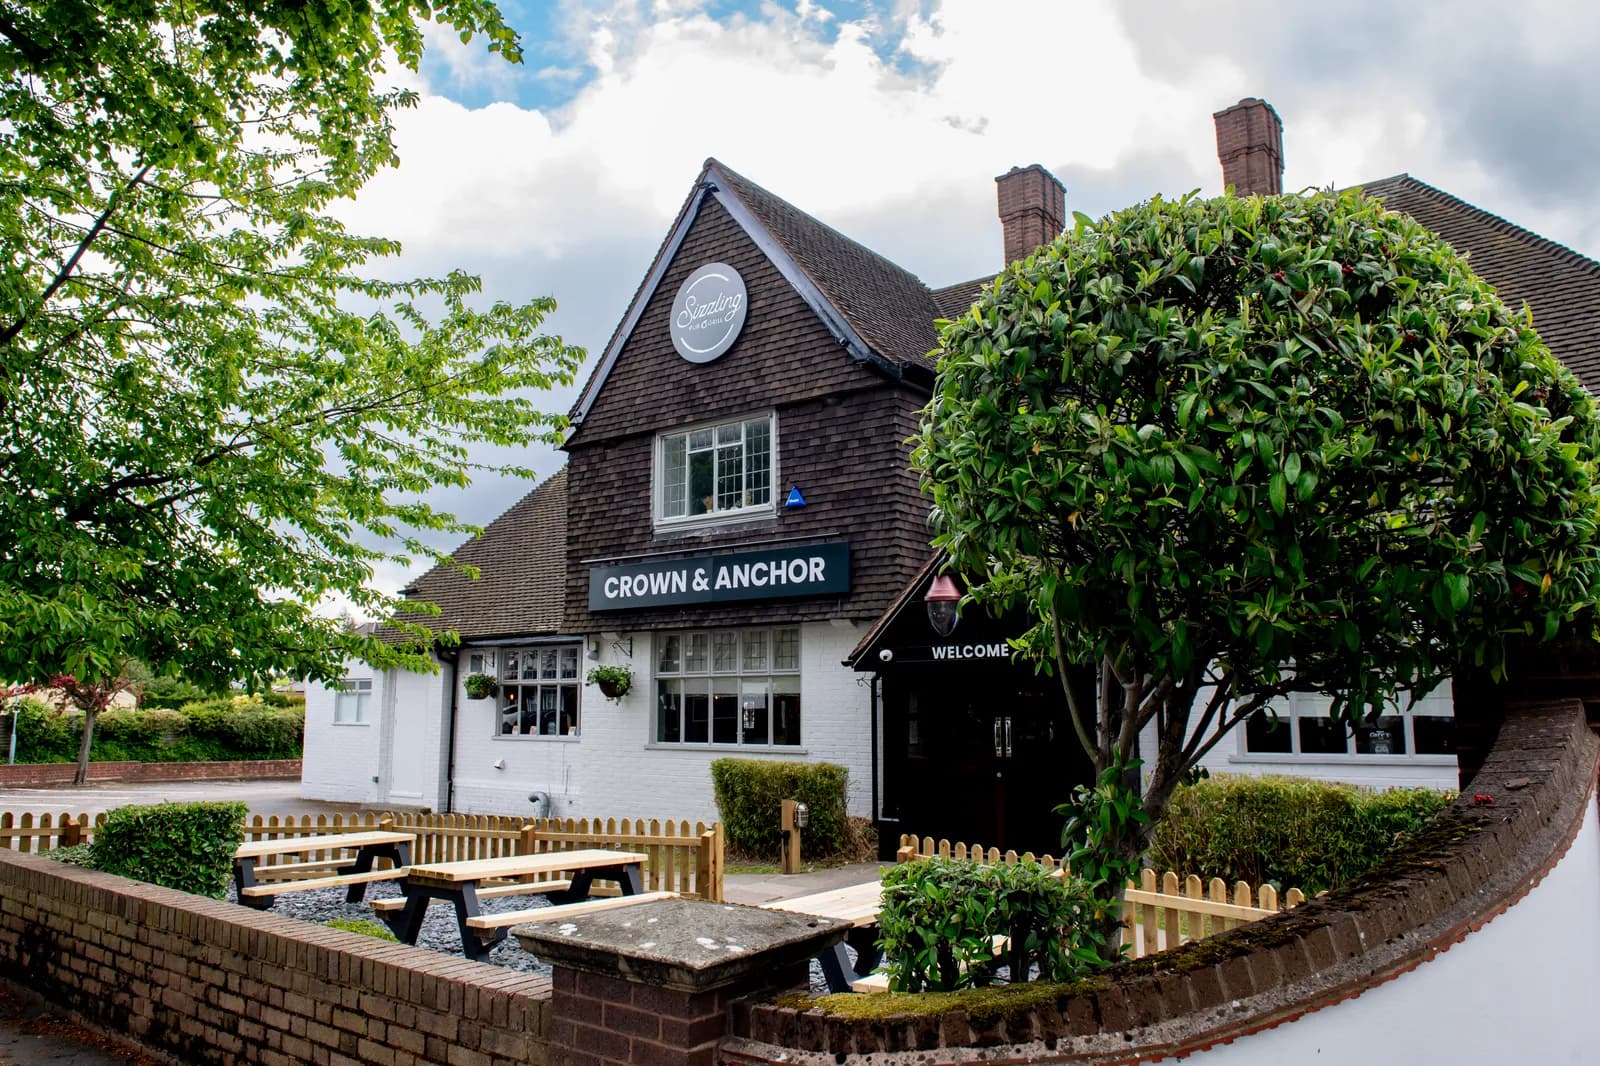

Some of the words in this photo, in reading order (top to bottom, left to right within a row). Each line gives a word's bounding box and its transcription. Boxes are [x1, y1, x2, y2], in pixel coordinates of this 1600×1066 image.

[677, 292, 742, 328] Sizzling
[604, 570, 687, 599] CROWN
[692, 567, 710, 592] &
[714, 556, 825, 590] ANCHOR
[931, 643, 1009, 659] WELCOME
